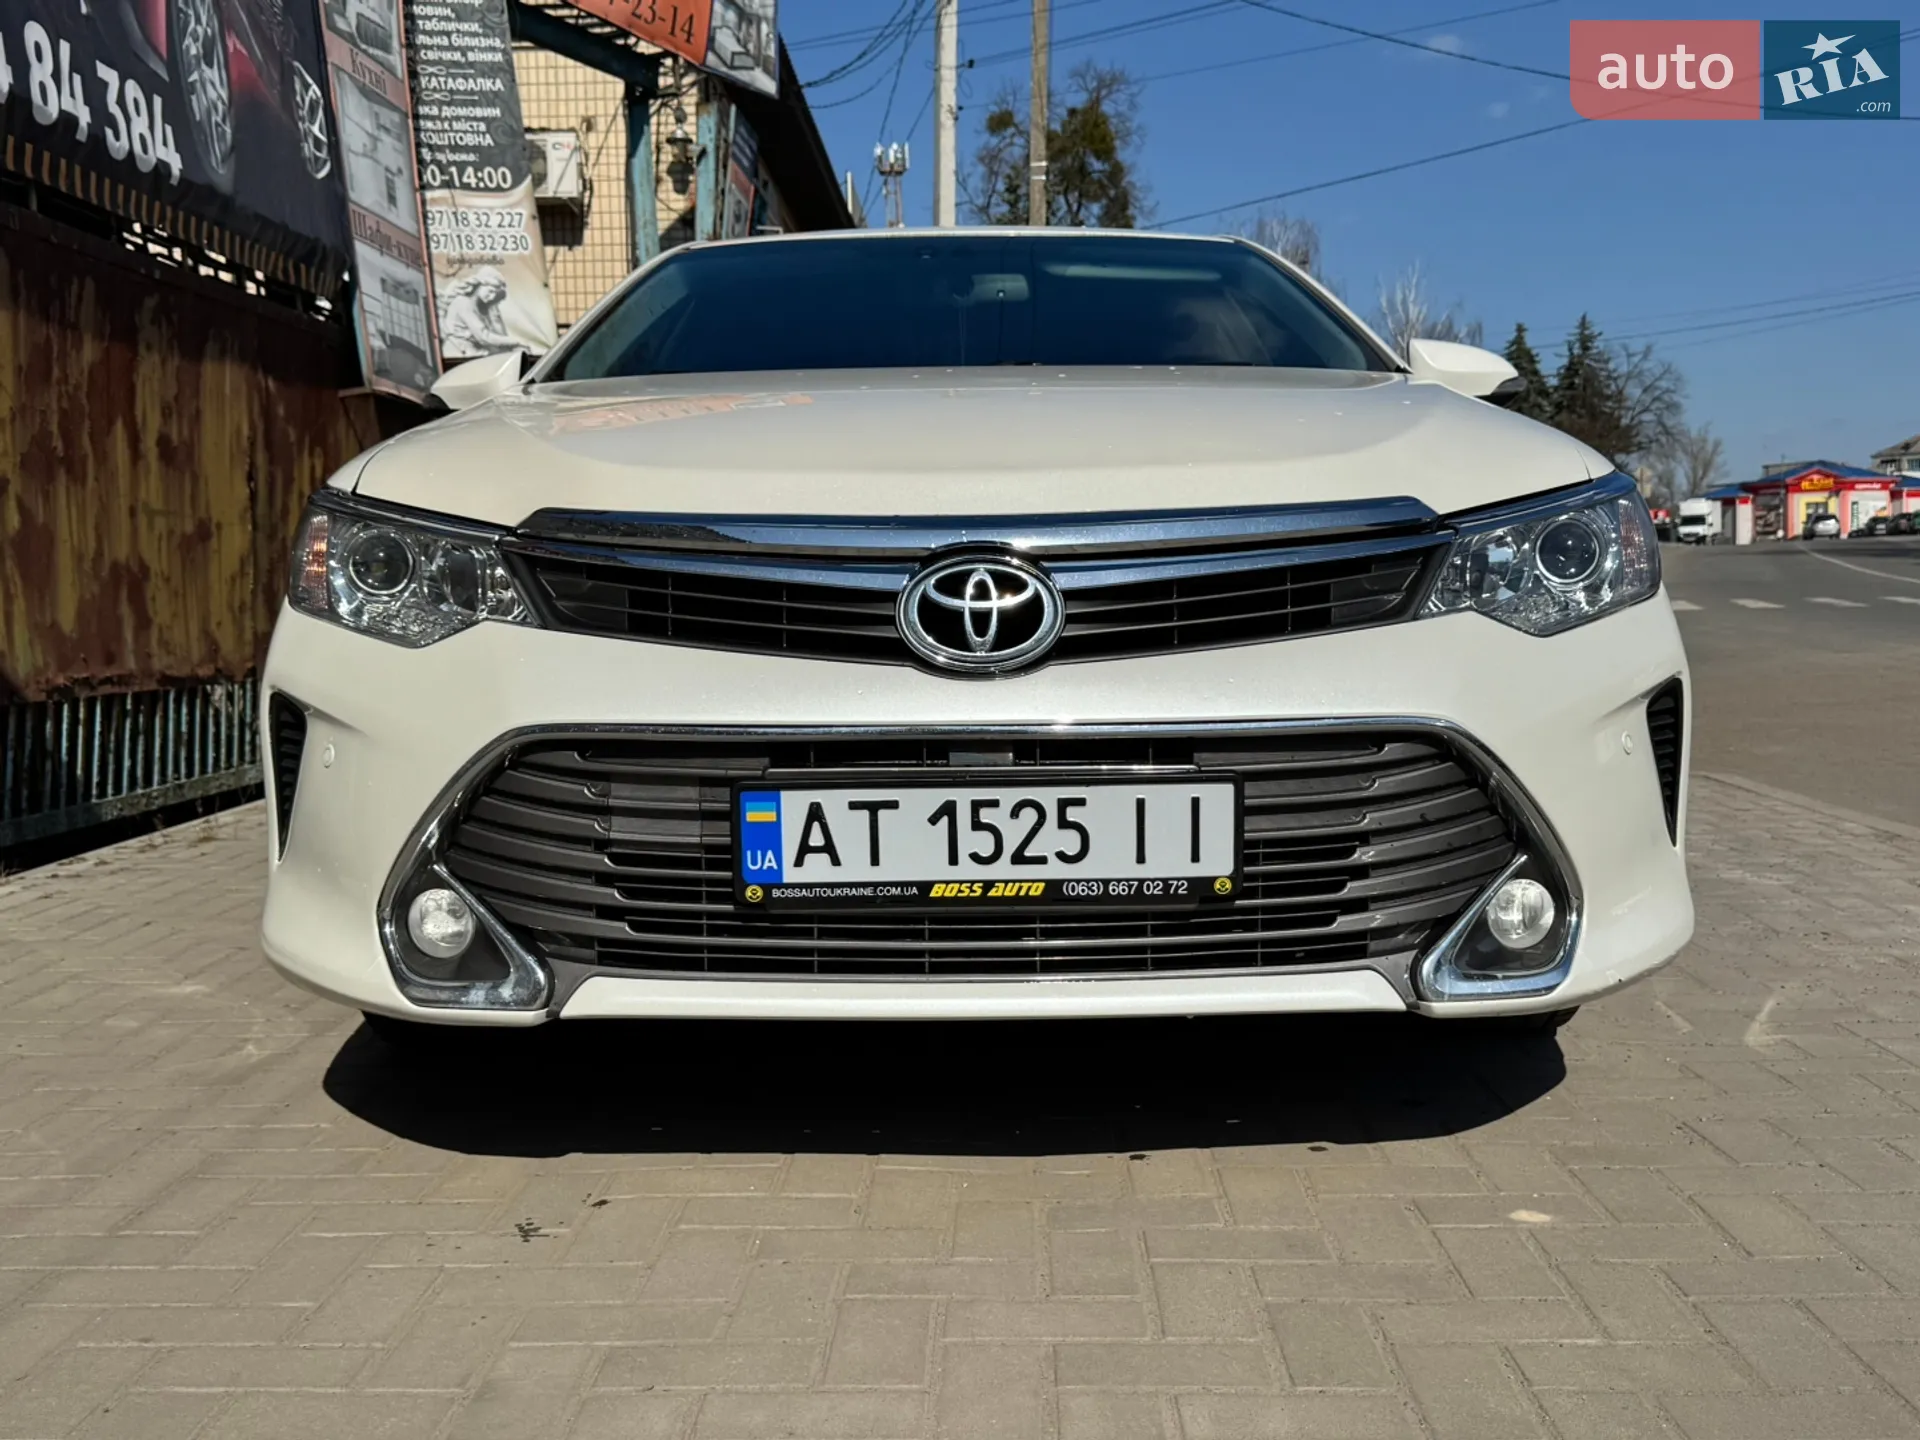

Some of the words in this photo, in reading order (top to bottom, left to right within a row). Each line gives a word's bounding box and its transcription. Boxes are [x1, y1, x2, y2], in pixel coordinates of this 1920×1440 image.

[417, 18, 483, 34] таблички,
[608, 0, 696, 46] -23-14
[450, 32, 505, 49] білизна,
[420, 47, 465, 62] свічки,
[467, 48, 503, 62] вінки
[420, 75, 505, 91] КАТАФАЛКА
[24, 20, 92, 143] 84
[96, 59, 183, 186] 384
[441, 105, 501, 118] домовин
[496, 211, 524, 228] 227
[499, 234, 530, 251] 230
[793, 800, 900, 868] AT
[927, 797, 1091, 866] 1525
[746, 849, 778, 870] UA
[771, 886, 919, 898] BOSSAUTOUKRAINE.COM.UA
[929, 882, 983, 897] BOSS
[986, 882, 1046, 897] AUTO
[1062, 881, 1104, 896] (063)
[1108, 881, 1138, 895] 667
[1142, 881, 1164, 895] 02
[1167, 880, 1188, 894] 72
